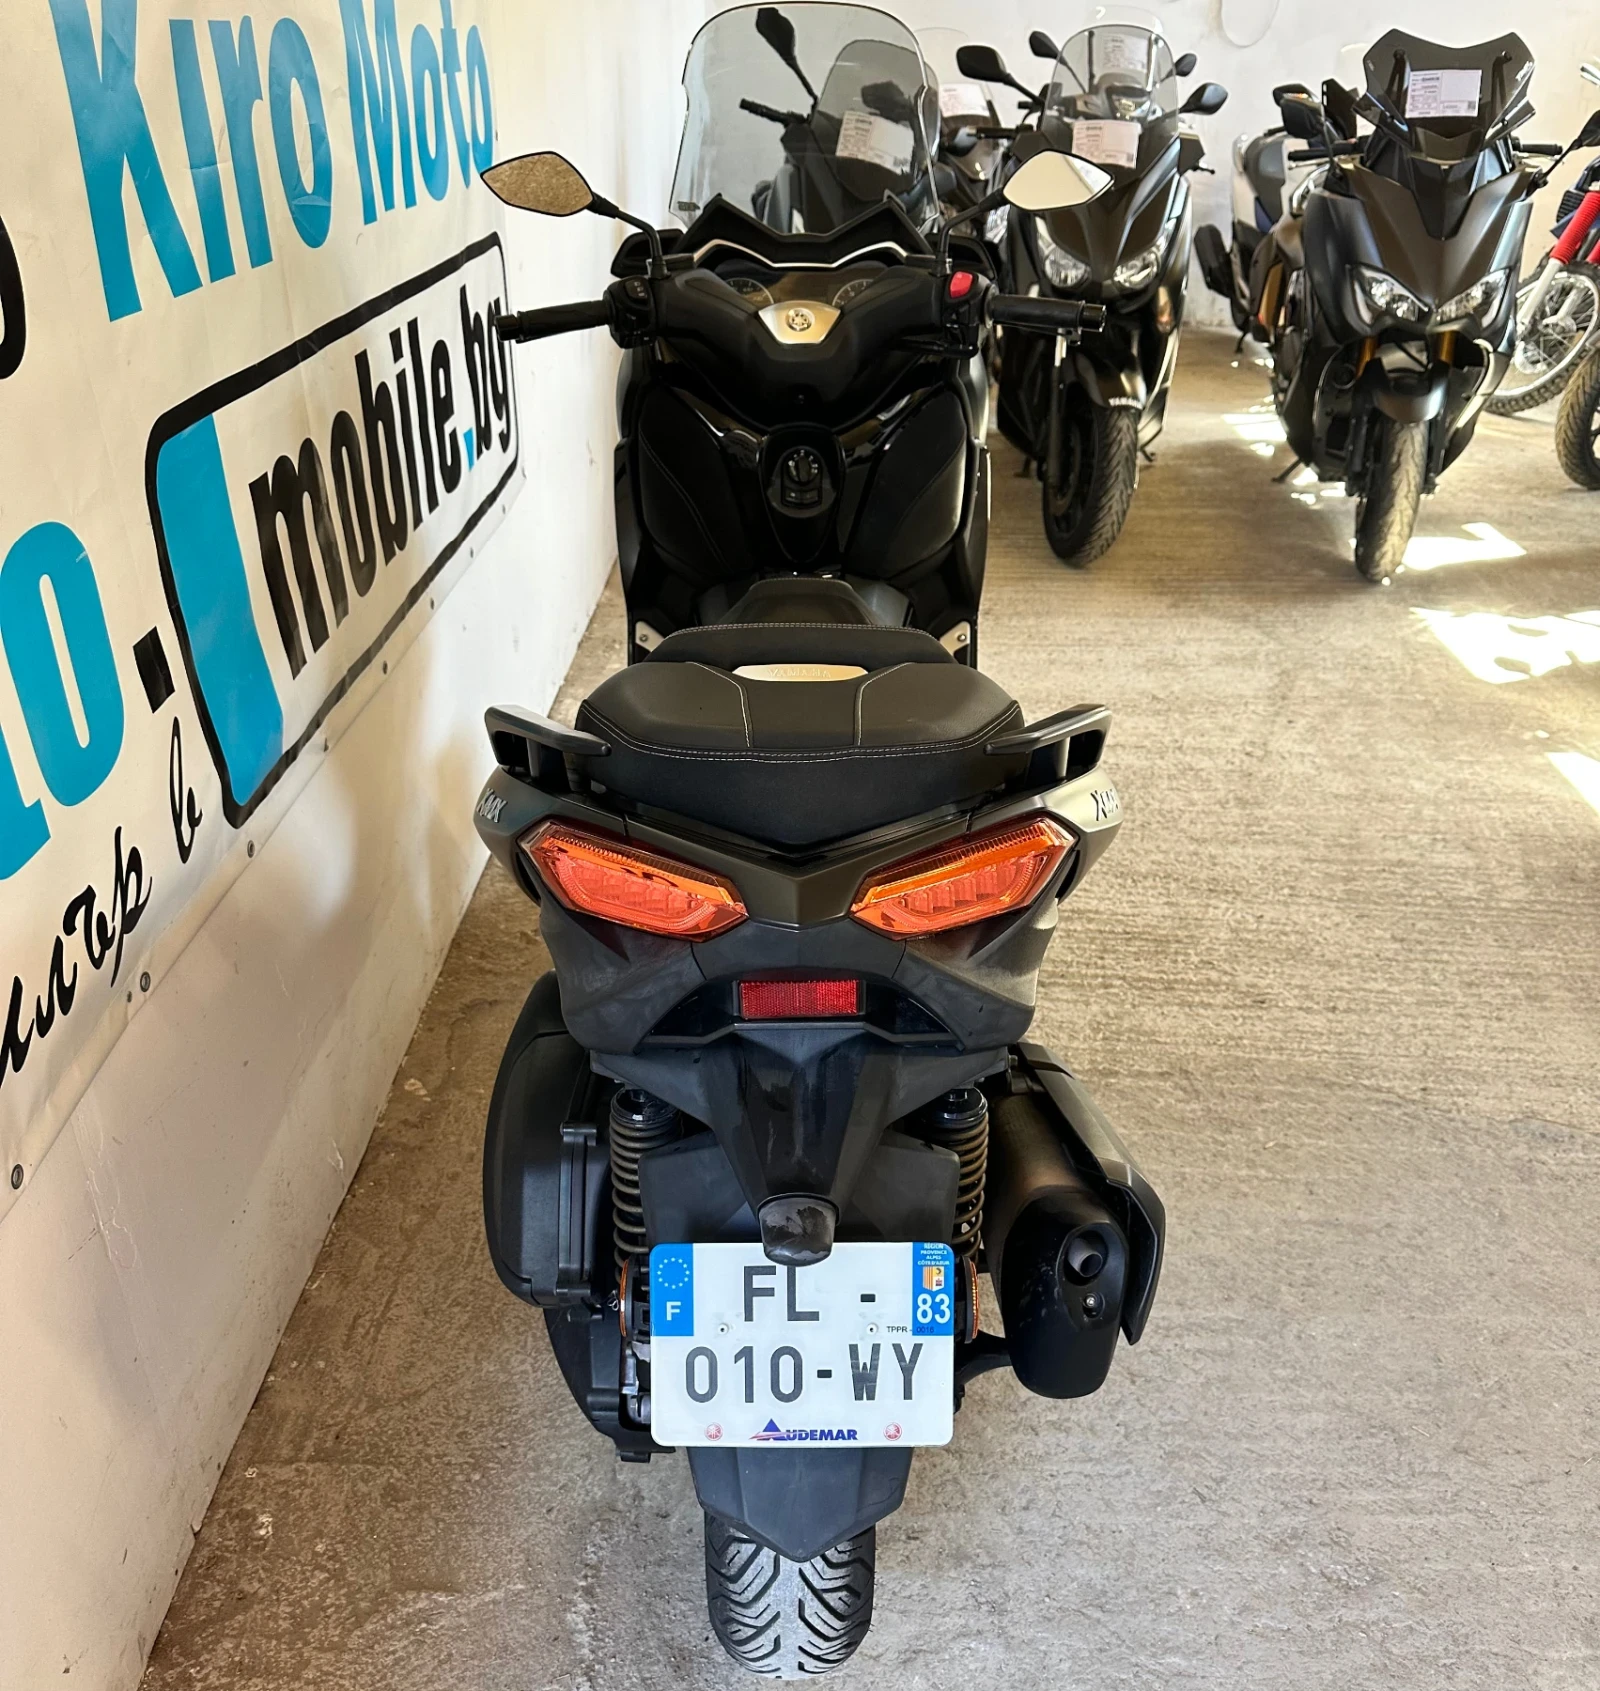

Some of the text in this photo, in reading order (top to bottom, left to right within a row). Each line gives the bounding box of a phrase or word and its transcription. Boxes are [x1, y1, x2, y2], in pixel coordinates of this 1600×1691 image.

[338, 0, 495, 225] Moto
[248, 284, 511, 679] mobile.bg
[768, 668, 831, 678] YAMAHA
[665, 1301, 682, 1321] F
[743, 1265, 820, 1322] FL
[916, 1293, 951, 1324] 83
